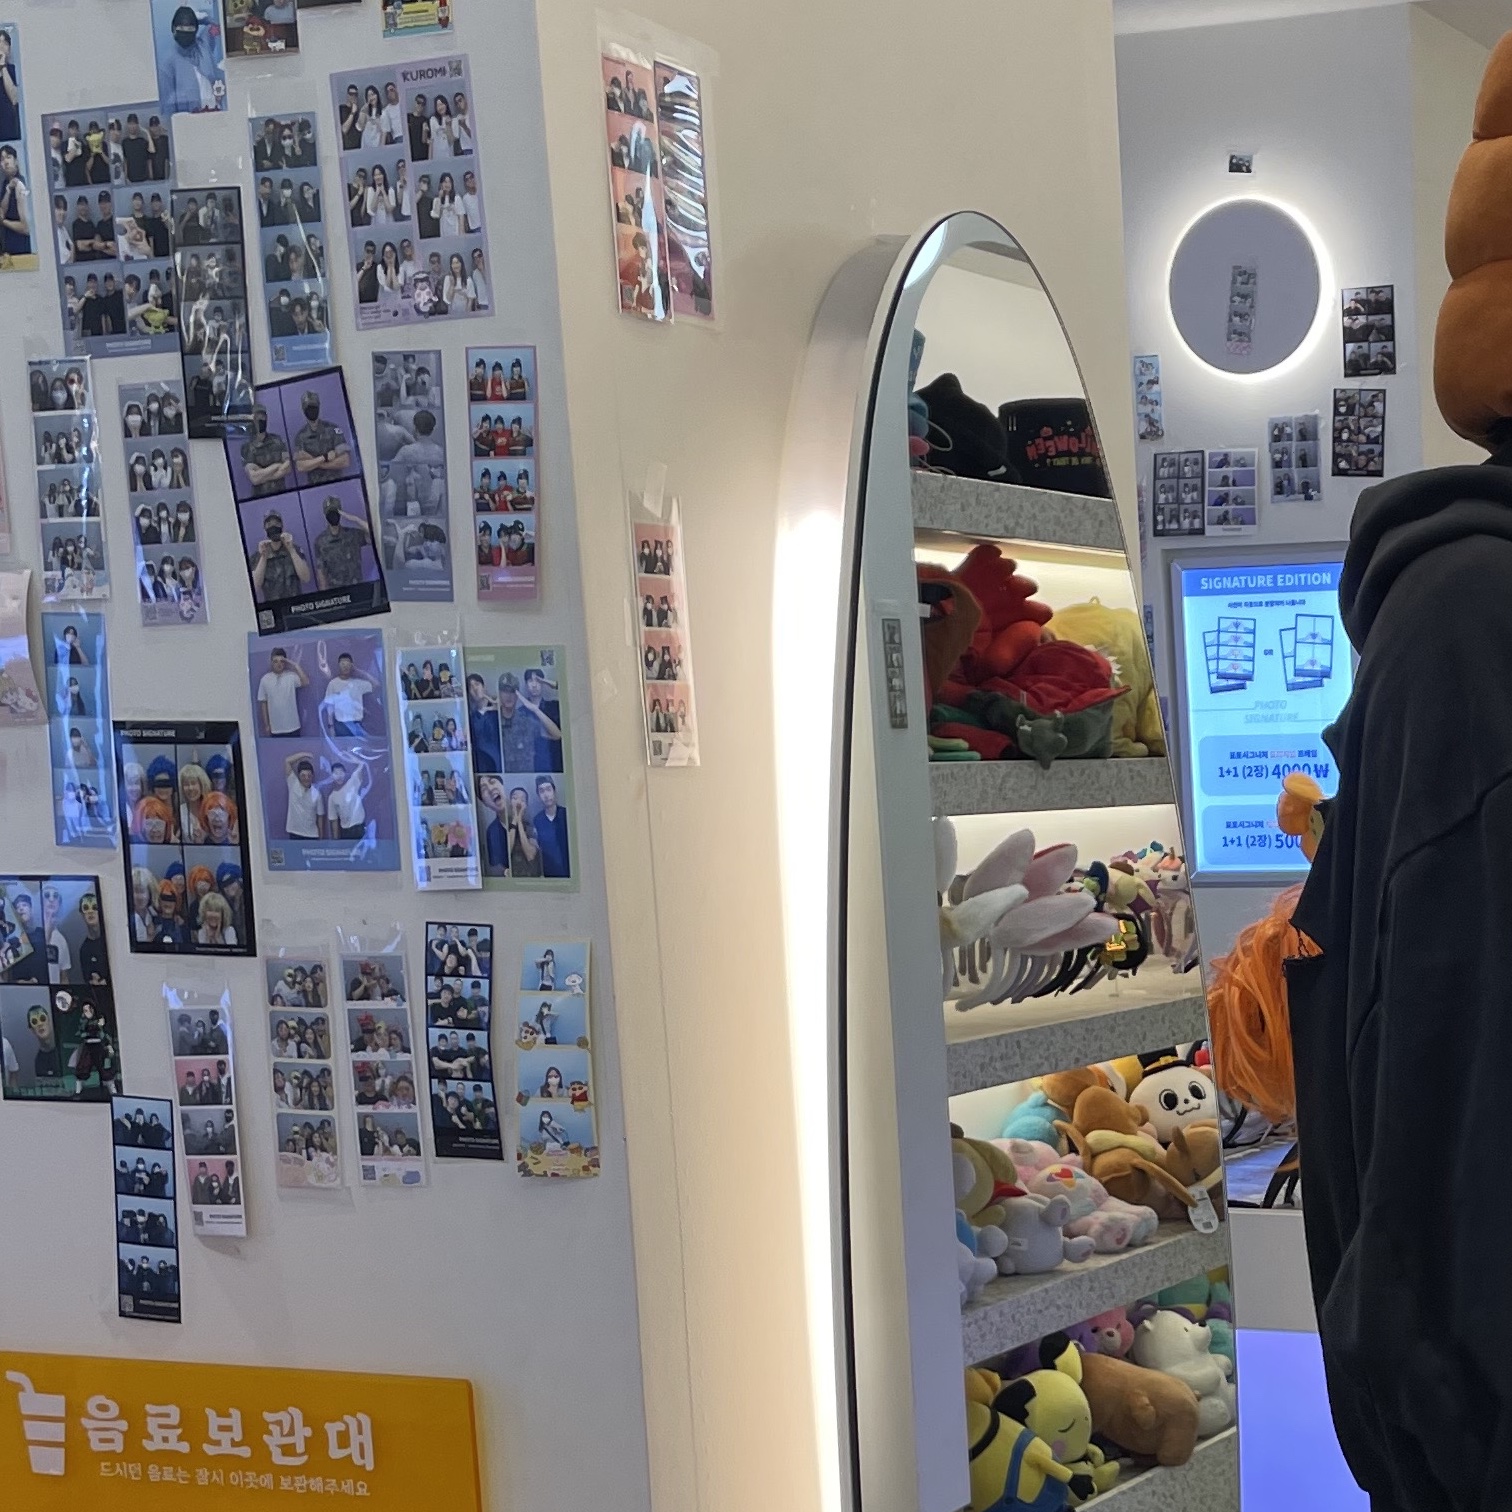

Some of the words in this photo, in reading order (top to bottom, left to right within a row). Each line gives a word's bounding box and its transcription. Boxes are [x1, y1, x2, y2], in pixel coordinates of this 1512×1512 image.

[401, 66, 447, 82] KUROMI
[1200, 574, 1274, 590] SIGNATURE
[1277, 572, 1332, 587] EDITION
[1254, 700, 1287, 710] PHOTO
[1218, 766, 1239, 778] 1+1
[1242, 764, 1269, 779] (2장)
[1222, 835, 1243, 847] 1+1
[1245, 833, 1272, 849] (2장)
[80, 1394, 375, 1471] 음료보관대
[147, 1463, 191, 1484] 음료는
[194, 1467, 225, 1486] 잠시
[229, 1470, 274, 1490] 이곳에
[279, 1474, 371, 1496] 보관해주세요
